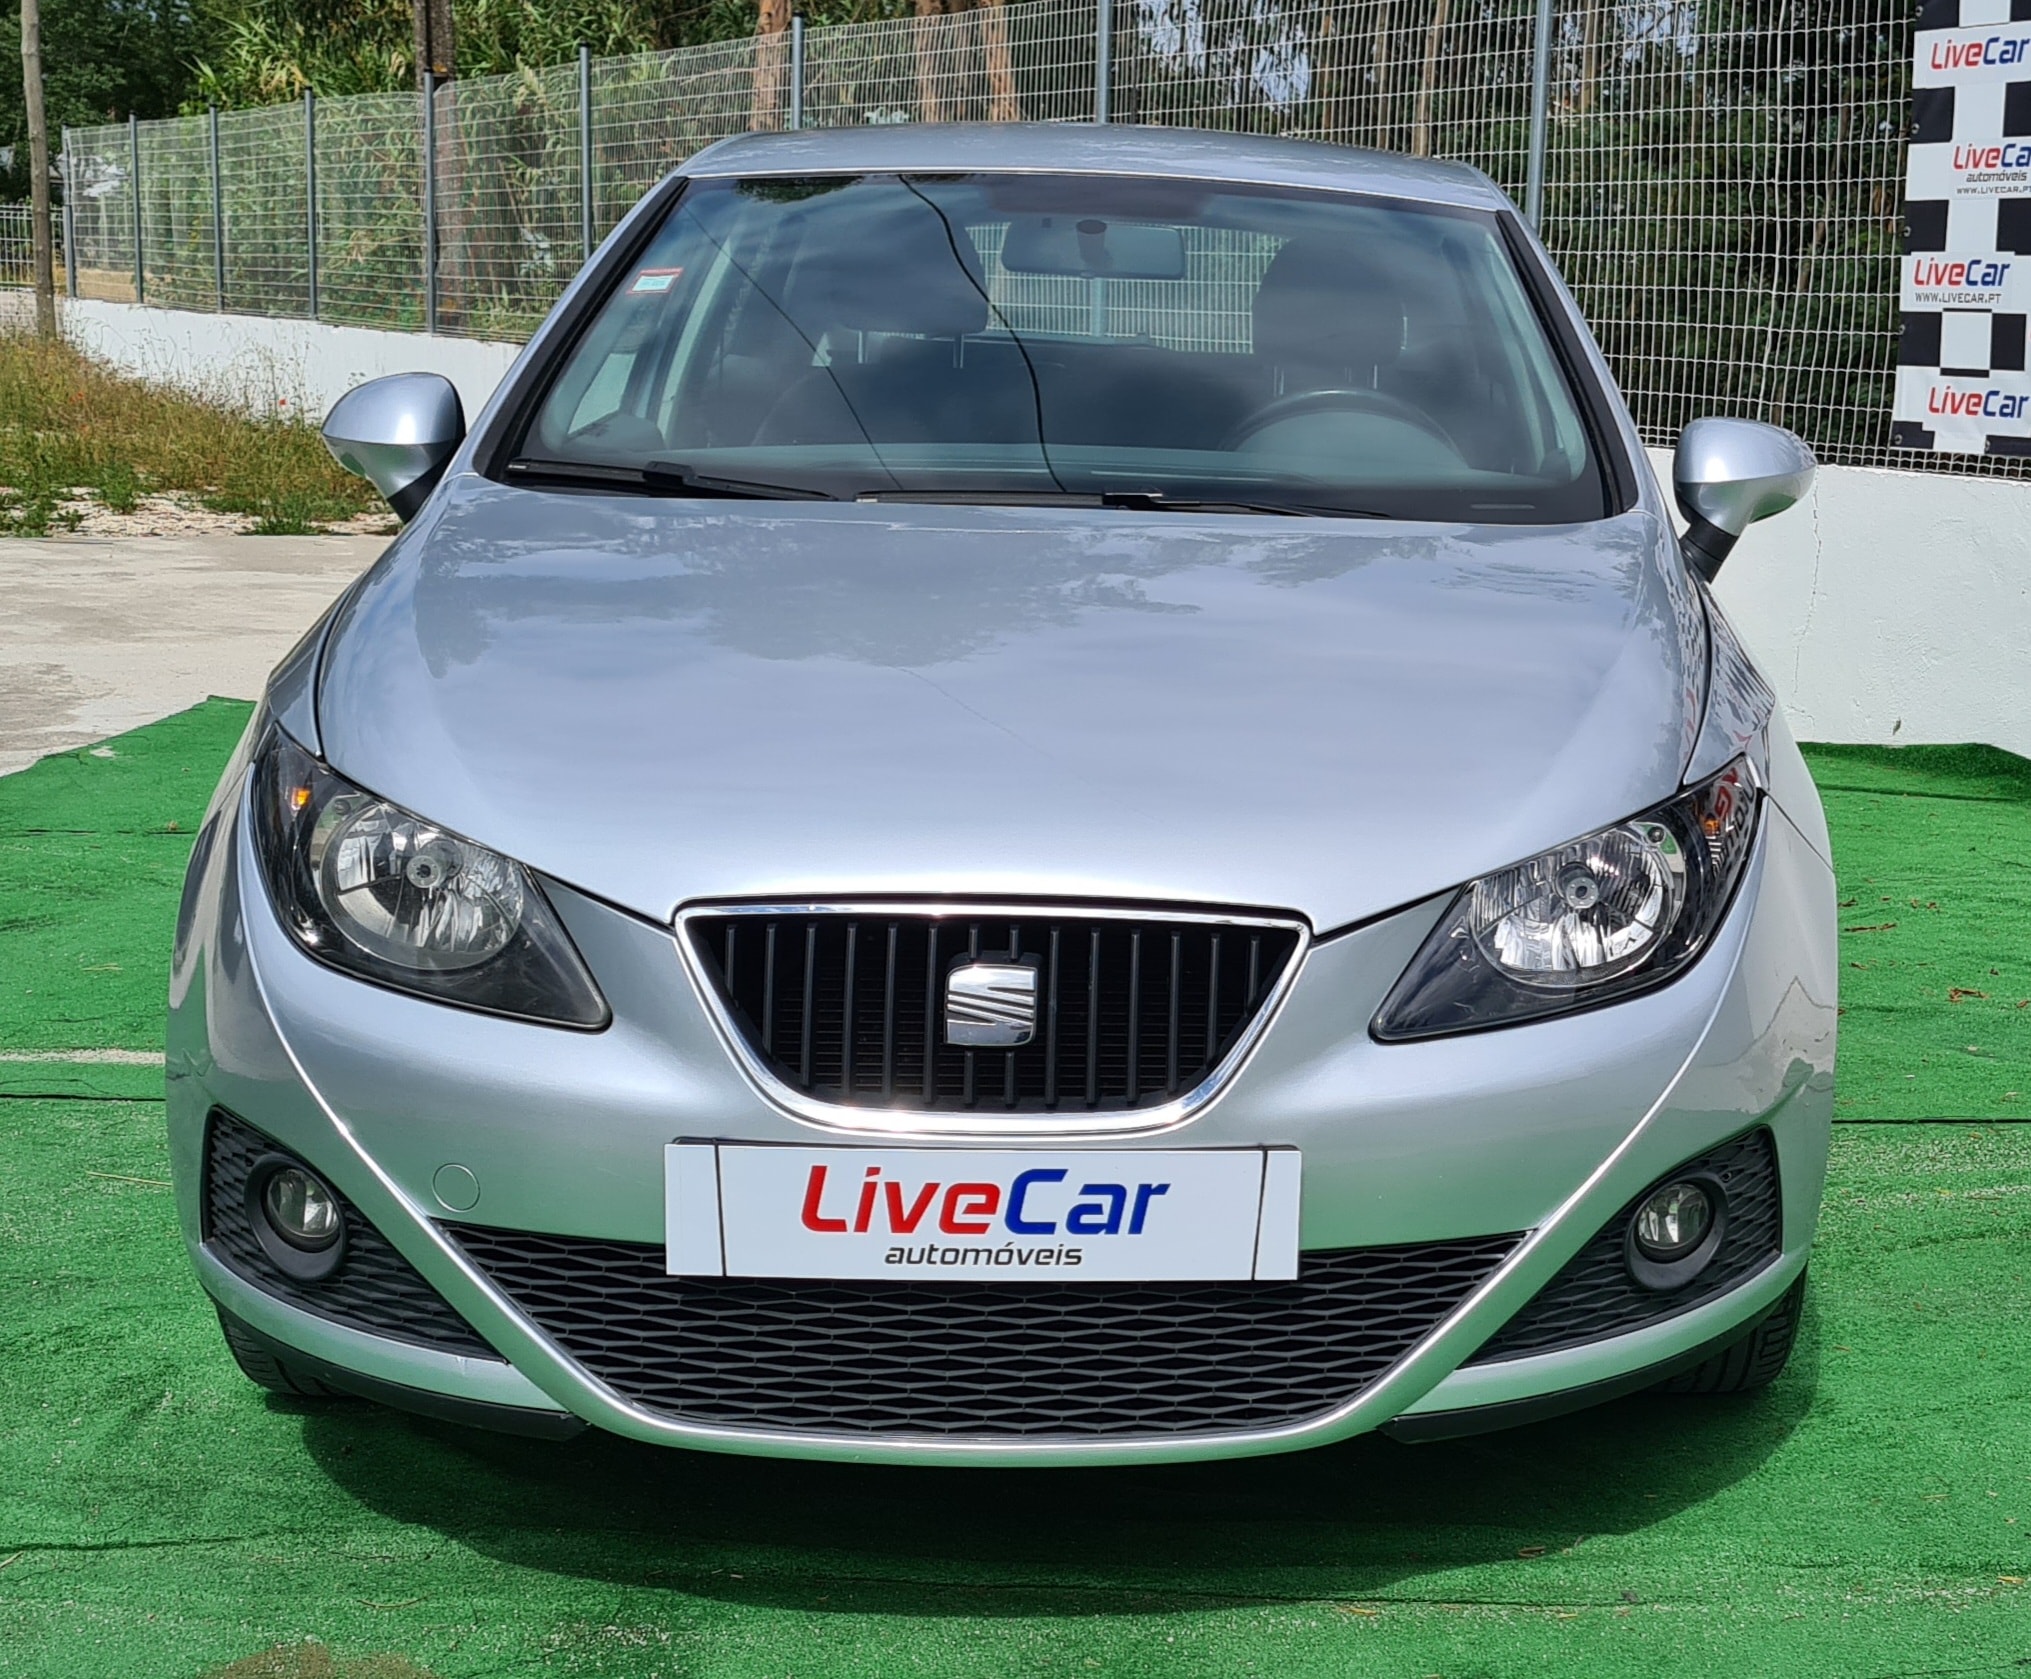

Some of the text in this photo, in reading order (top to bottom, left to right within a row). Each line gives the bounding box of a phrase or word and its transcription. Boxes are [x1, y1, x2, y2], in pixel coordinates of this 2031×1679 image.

[1931, 36, 2030, 70] LiveCar
[1966, 169, 2027, 183] automóveis
[1914, 257, 2010, 287] LiveCar
[1915, 292, 2002, 304] WWW.LIVECAR.PT
[1928, 385, 2030, 419] LiveCar
[800, 1165, 1171, 1235] LiveCar
[884, 1242, 1084, 1267] automóveis
